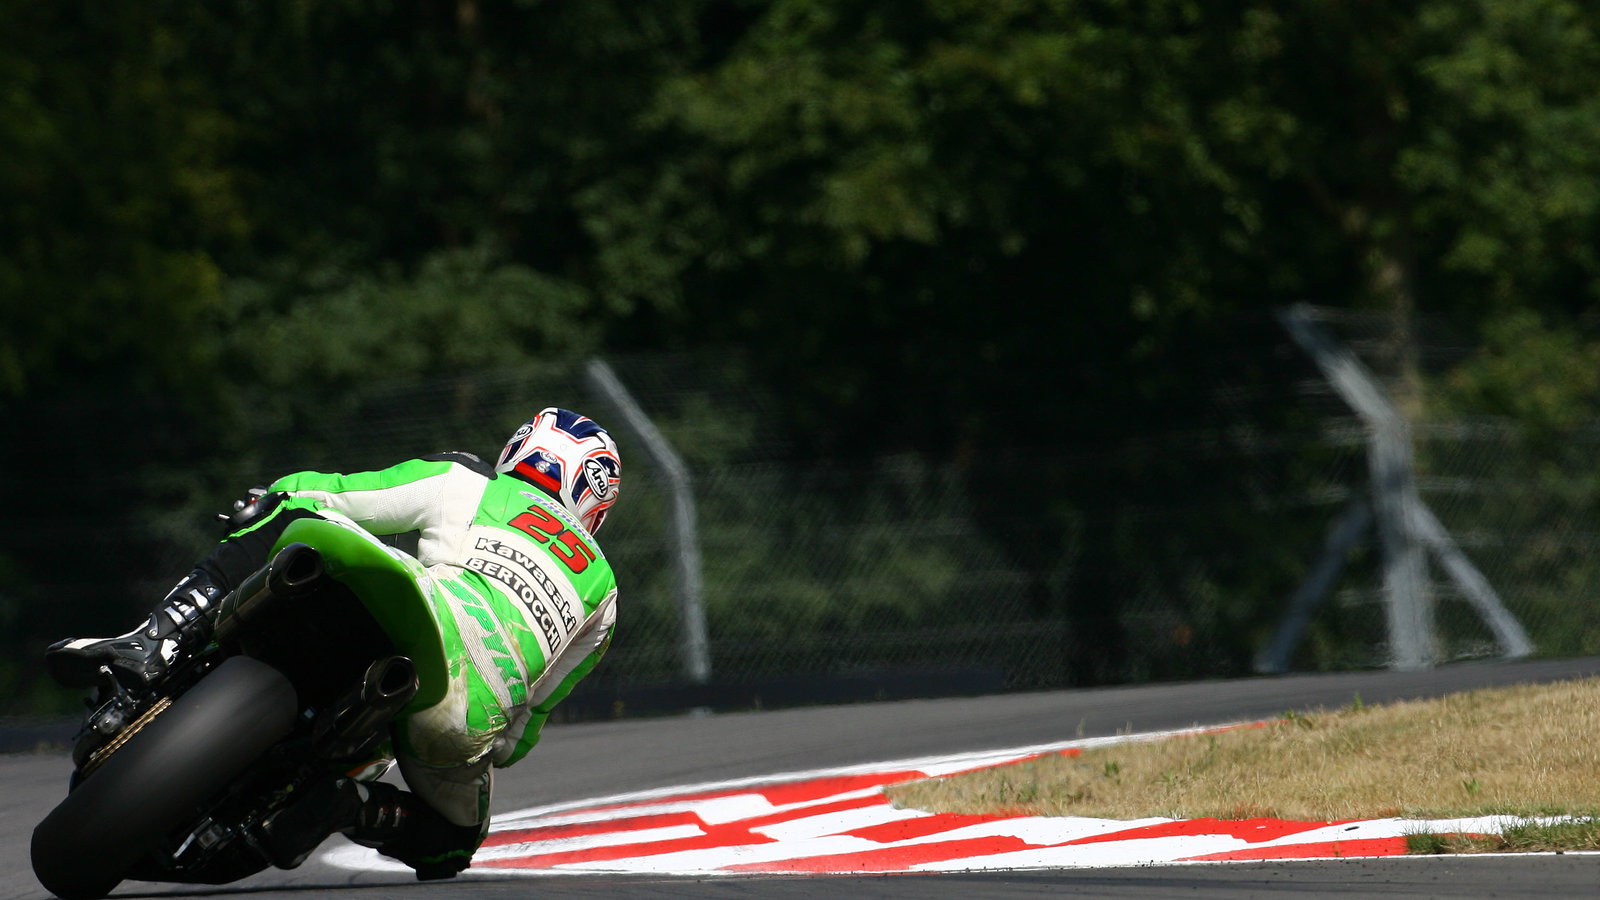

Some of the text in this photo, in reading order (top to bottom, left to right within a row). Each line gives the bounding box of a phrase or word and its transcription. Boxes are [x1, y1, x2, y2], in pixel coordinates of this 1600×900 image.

[586, 461, 608, 494] Arai
[507, 504, 596, 574] 25
[466, 557, 562, 654] BERTOCCHI
[475, 537, 577, 635] Kawasaki
